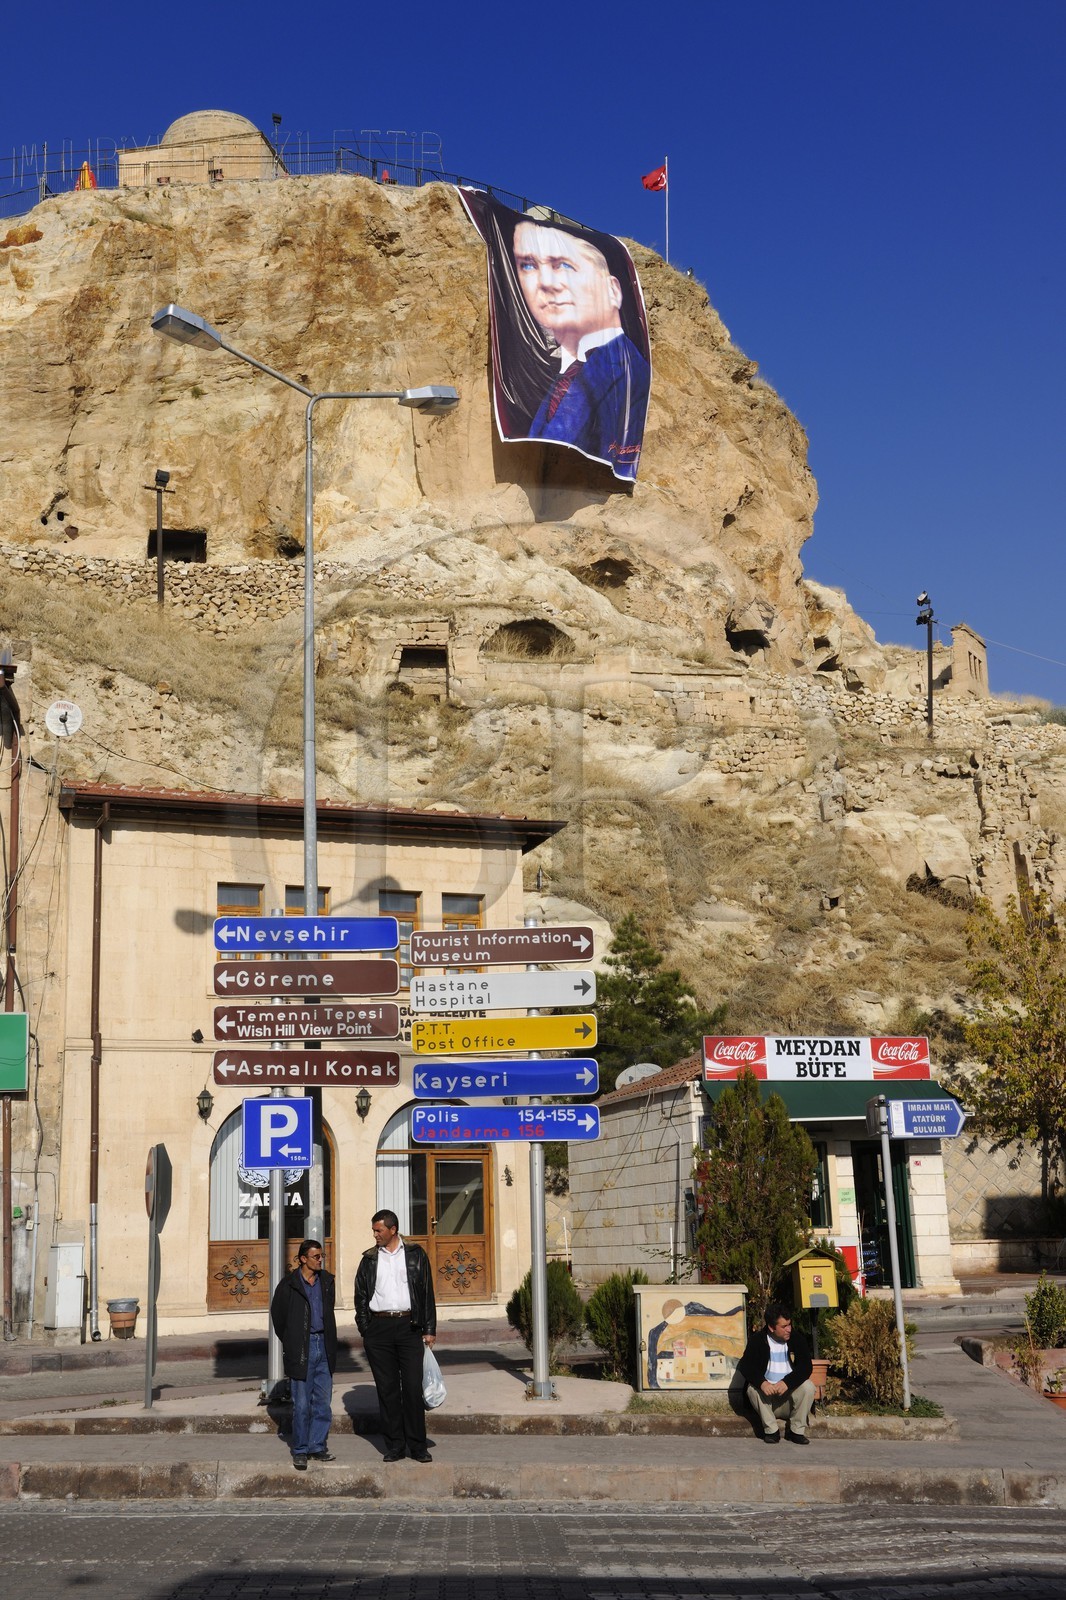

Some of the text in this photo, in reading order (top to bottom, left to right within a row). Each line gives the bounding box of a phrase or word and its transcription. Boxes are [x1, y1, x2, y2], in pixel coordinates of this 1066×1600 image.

[236, 926, 349, 943] Nevşehir
[414, 932, 572, 948] Tourist Information
[414, 950, 490, 962] Museum
[236, 971, 334, 986] Göreme
[415, 980, 488, 992] Hastane
[416, 994, 491, 1008] Hospital
[237, 1008, 383, 1023] Temenni Tepesi
[237, 1022, 372, 1037] Wish Hill View Point
[416, 1023, 455, 1036] P.T.T.
[416, 1036, 455, 1050] Post
[463, 1036, 516, 1048] Office
[775, 1040, 860, 1056] MEYDAN
[237, 1061, 396, 1077] Asmalı Konak
[796, 1057, 846, 1077] BÜFE
[415, 1072, 508, 1091] Kayseri
[416, 1109, 576, 1123] Polis 154-155
[912, 1114, 946, 1122] ATATÜRK
[260, 1105, 298, 1157] P
[417, 1125, 544, 1139] Jandarma 156
